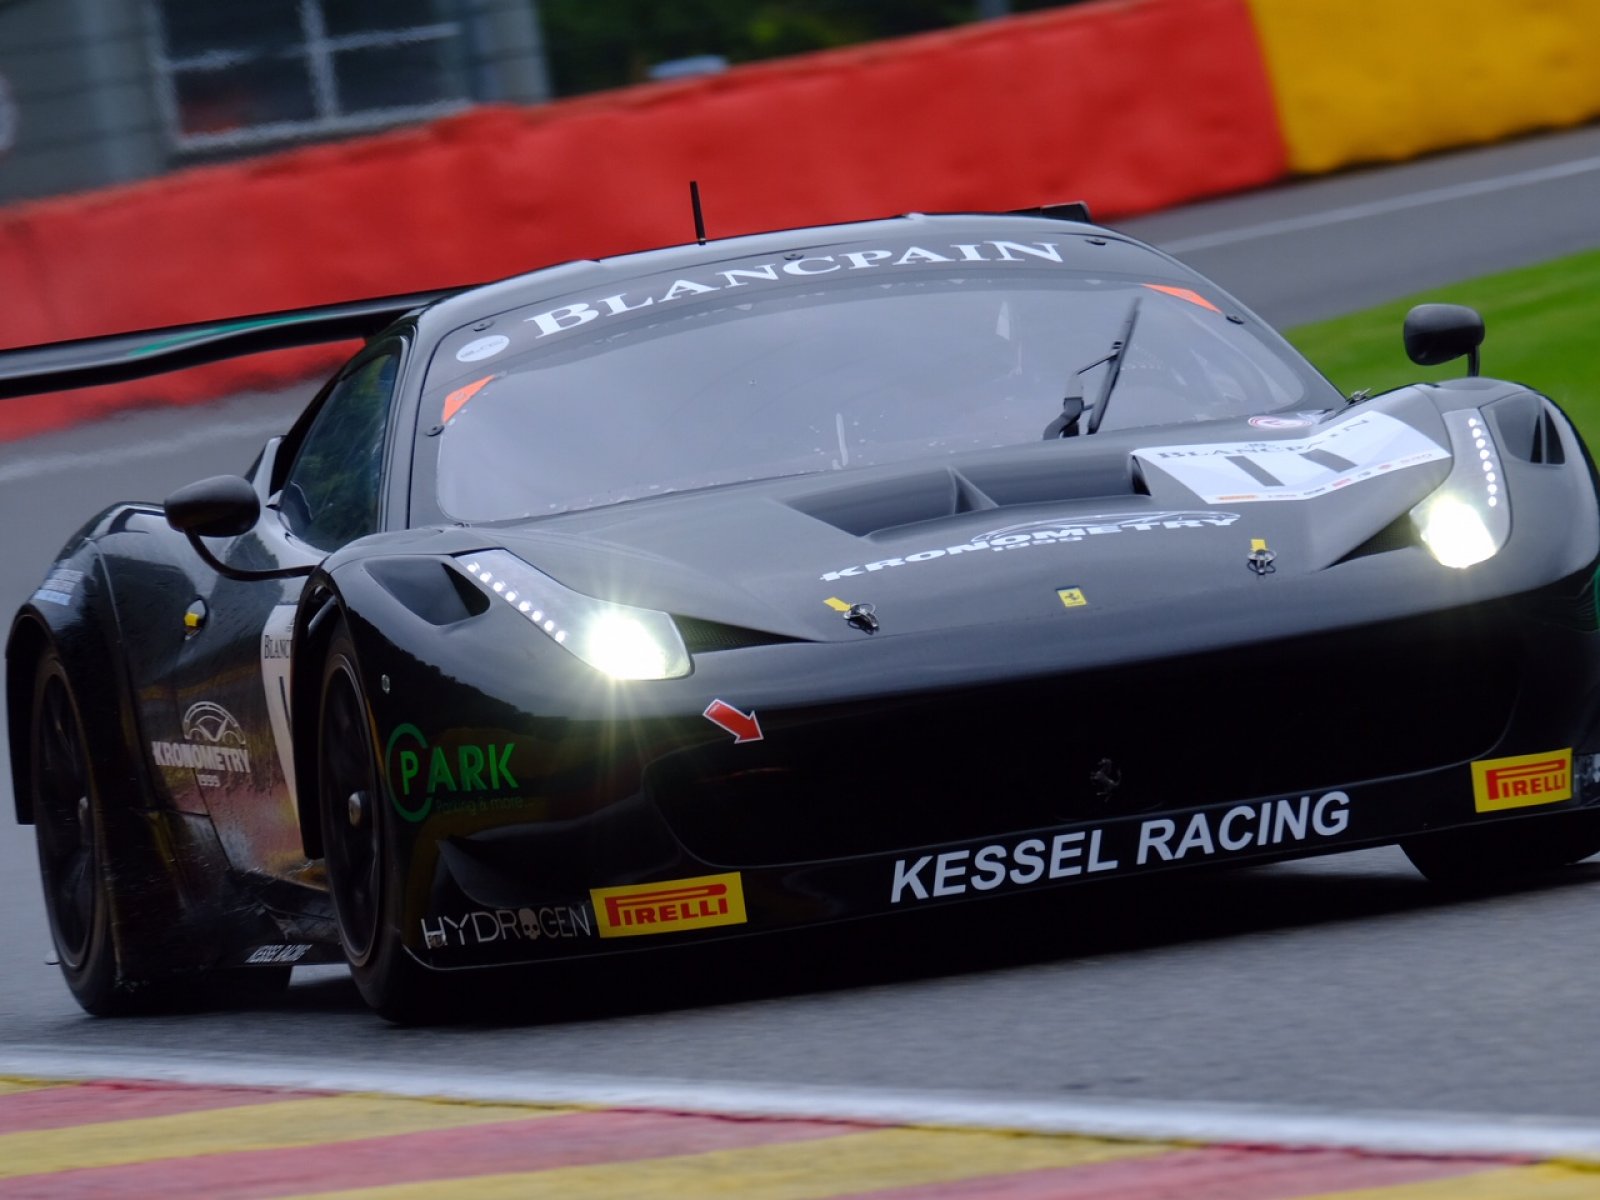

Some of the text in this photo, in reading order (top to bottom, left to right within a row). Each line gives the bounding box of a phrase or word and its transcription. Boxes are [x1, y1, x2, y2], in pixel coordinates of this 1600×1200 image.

[524, 239, 1065, 338] BLANCPAIN
[1157, 418, 1370, 459] BLANCPAIN
[1225, 448, 1359, 487] 11
[819, 518, 1239, 581] KRONOMETRY
[151, 741, 251, 773] KRONOMETRY
[1486, 758, 1567, 801] PIRELLI
[890, 791, 1351, 904] KESSEL RACING
[605, 882, 729, 928] PIRELLI
